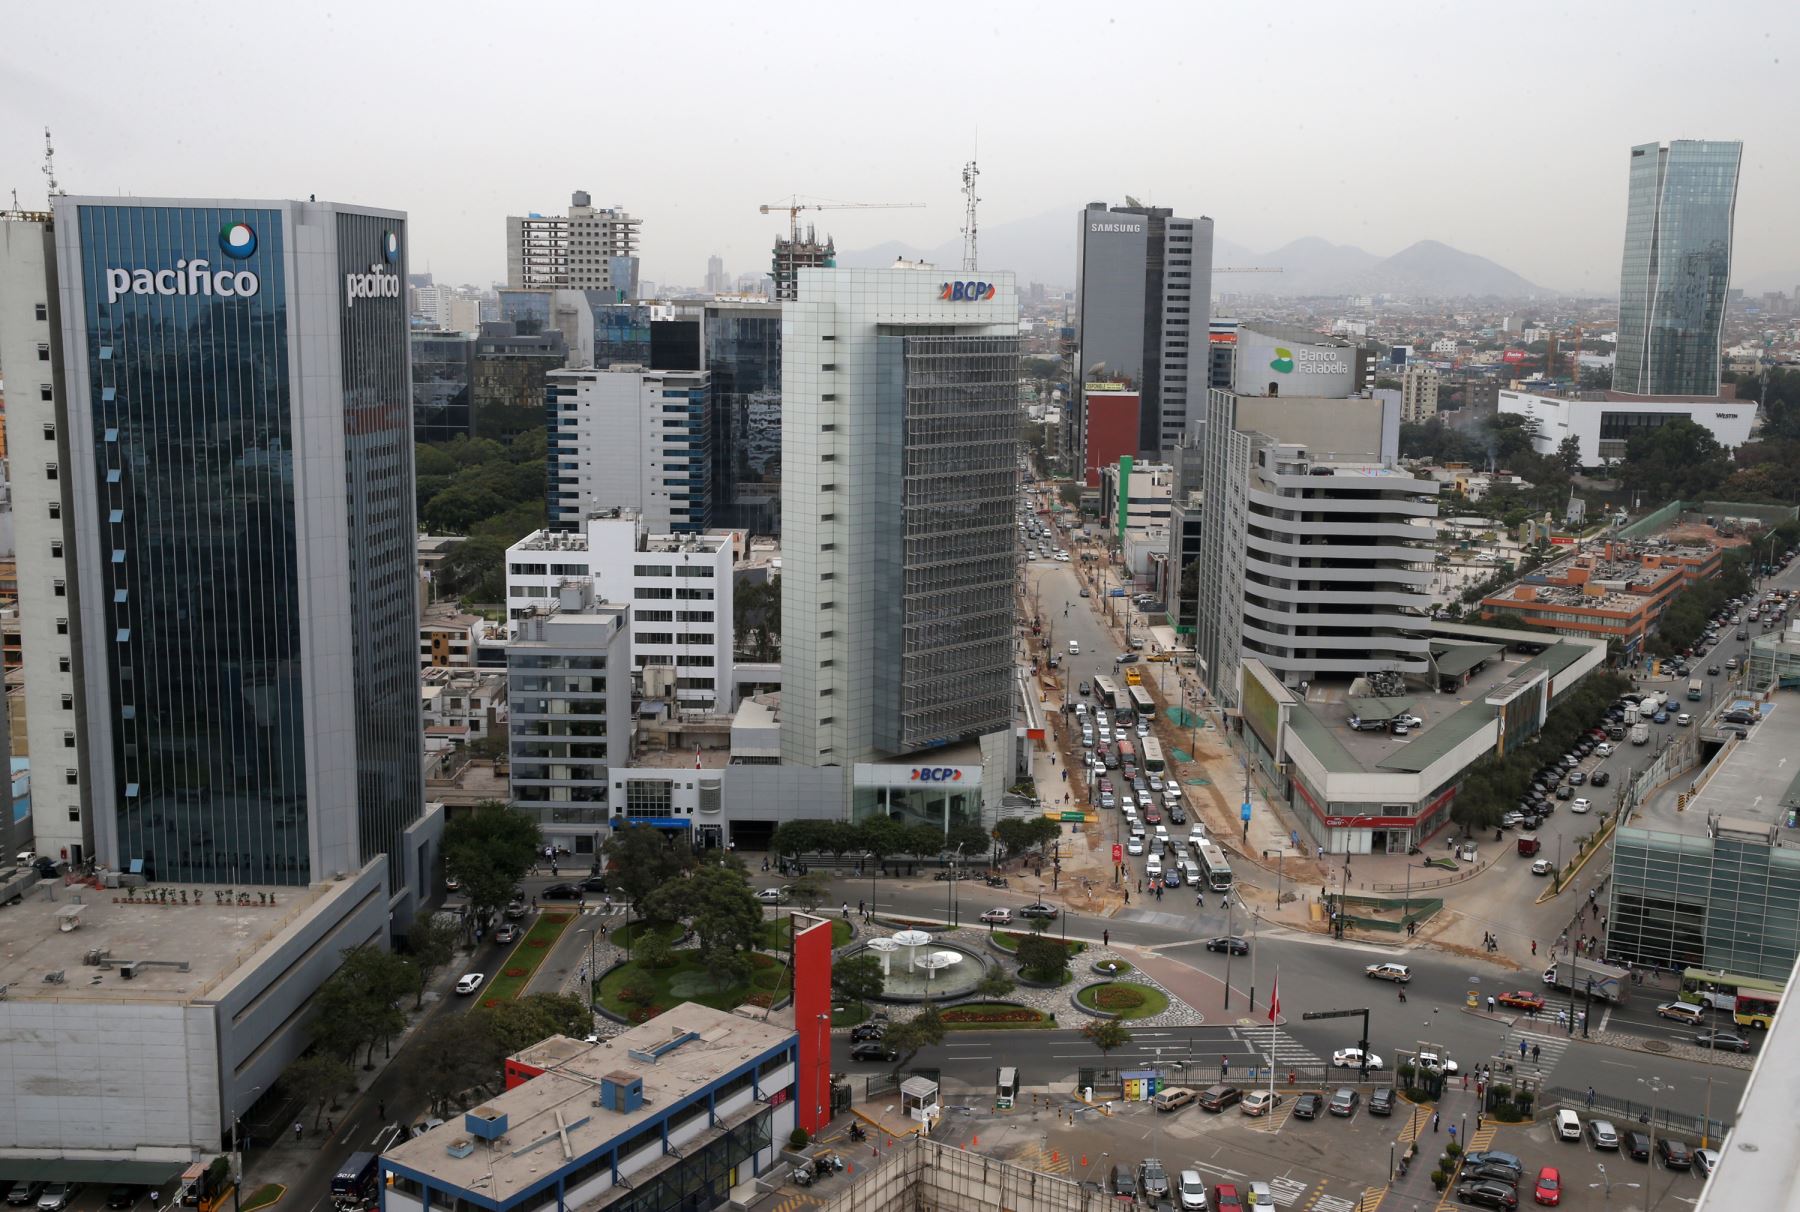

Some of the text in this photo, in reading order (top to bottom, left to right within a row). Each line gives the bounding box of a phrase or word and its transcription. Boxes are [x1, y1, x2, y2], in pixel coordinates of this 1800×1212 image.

[1091, 223, 1141, 233] SAMSUNG
[952, 281, 987, 301] BCP
[1299, 349, 1337, 361] Banco
[1298, 361, 1348, 374] Falabella
[920, 767, 953, 781] BCP
